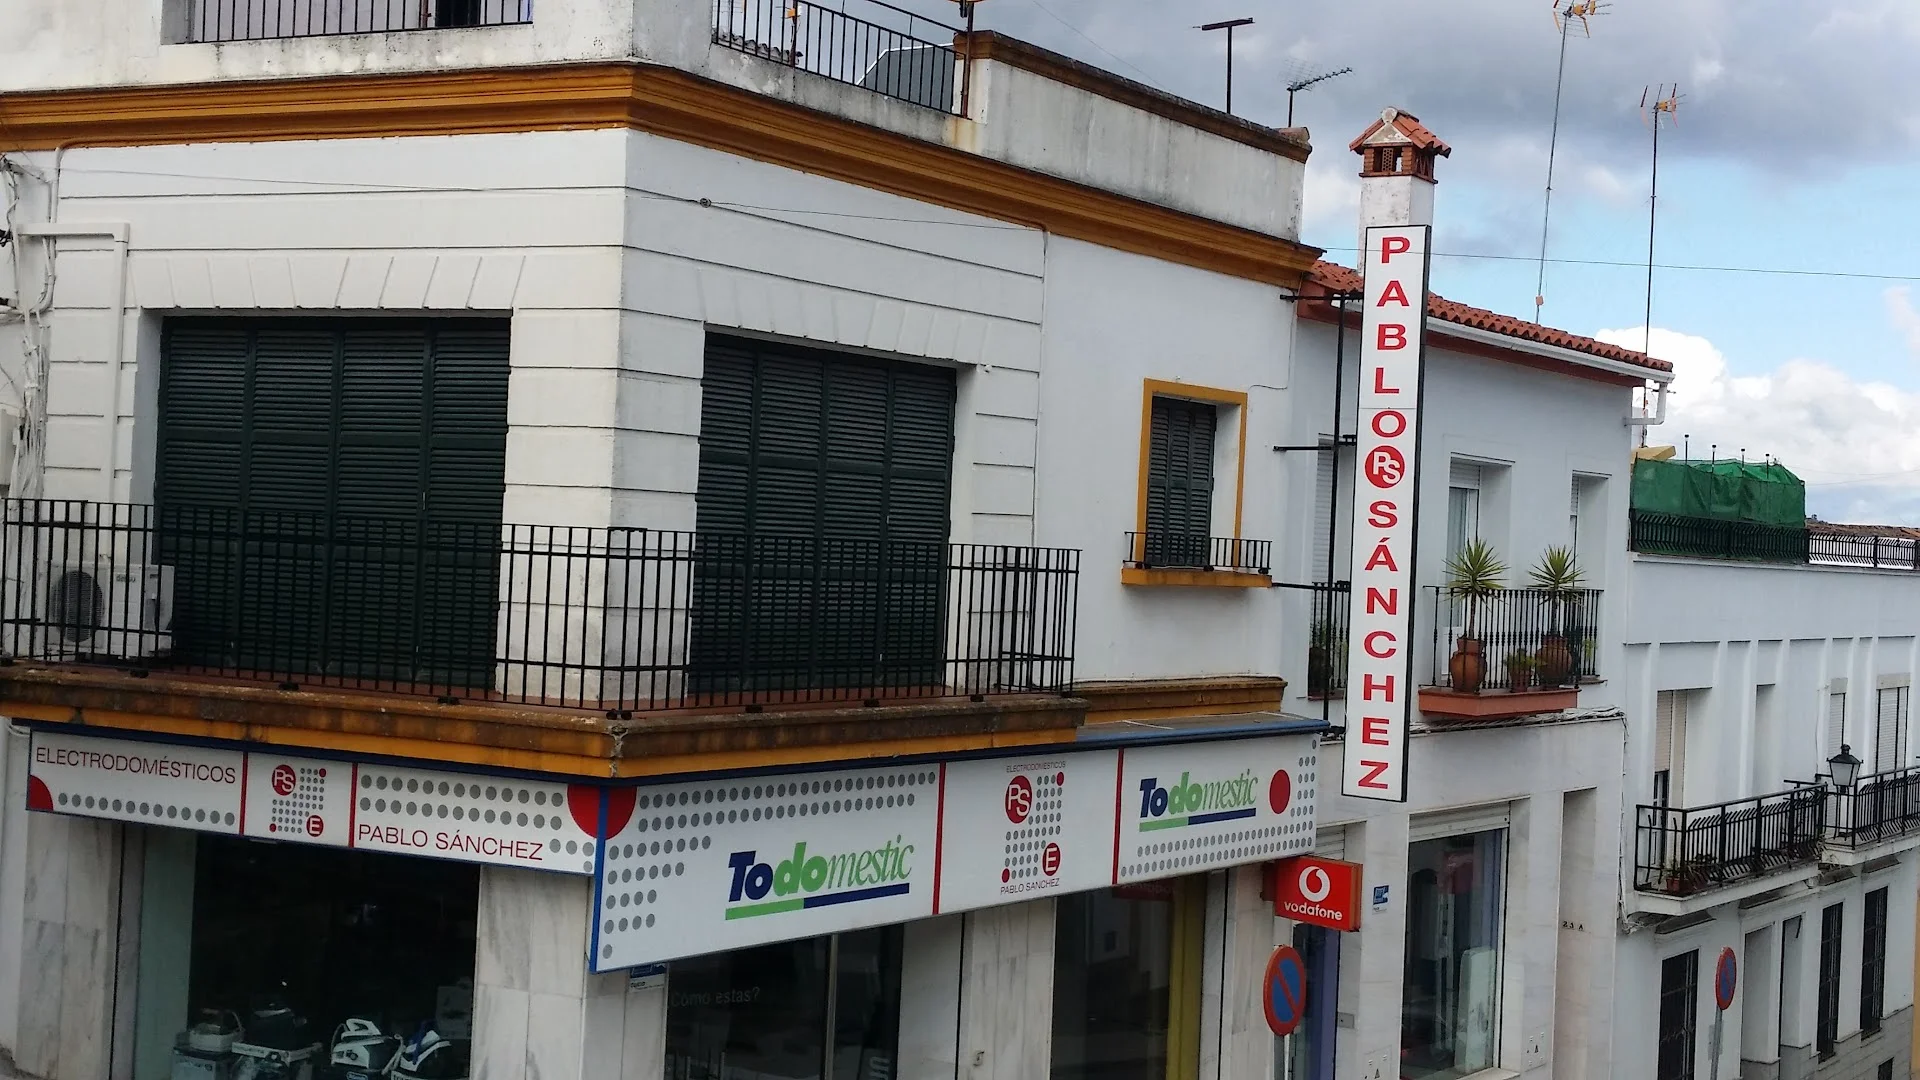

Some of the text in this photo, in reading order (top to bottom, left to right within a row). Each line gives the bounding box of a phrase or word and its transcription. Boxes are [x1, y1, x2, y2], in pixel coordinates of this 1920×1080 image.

[1371, 236, 1410, 438] PABLO
[1358, 500, 1398, 789] SÁNCHEZ
[36, 747, 236, 784] ELECTRODOMÉSTICOS
[1139, 769, 1259, 819] Todomestic
[308, 817, 321, 835] E
[358, 824, 543, 860] PABLO SÁNCHEZ
[728, 834, 915, 903] Todomestic
[1045, 847, 1058, 872] E
[1000, 885, 1024, 895] PABLO
[1284, 901, 1343, 921] vodafone
